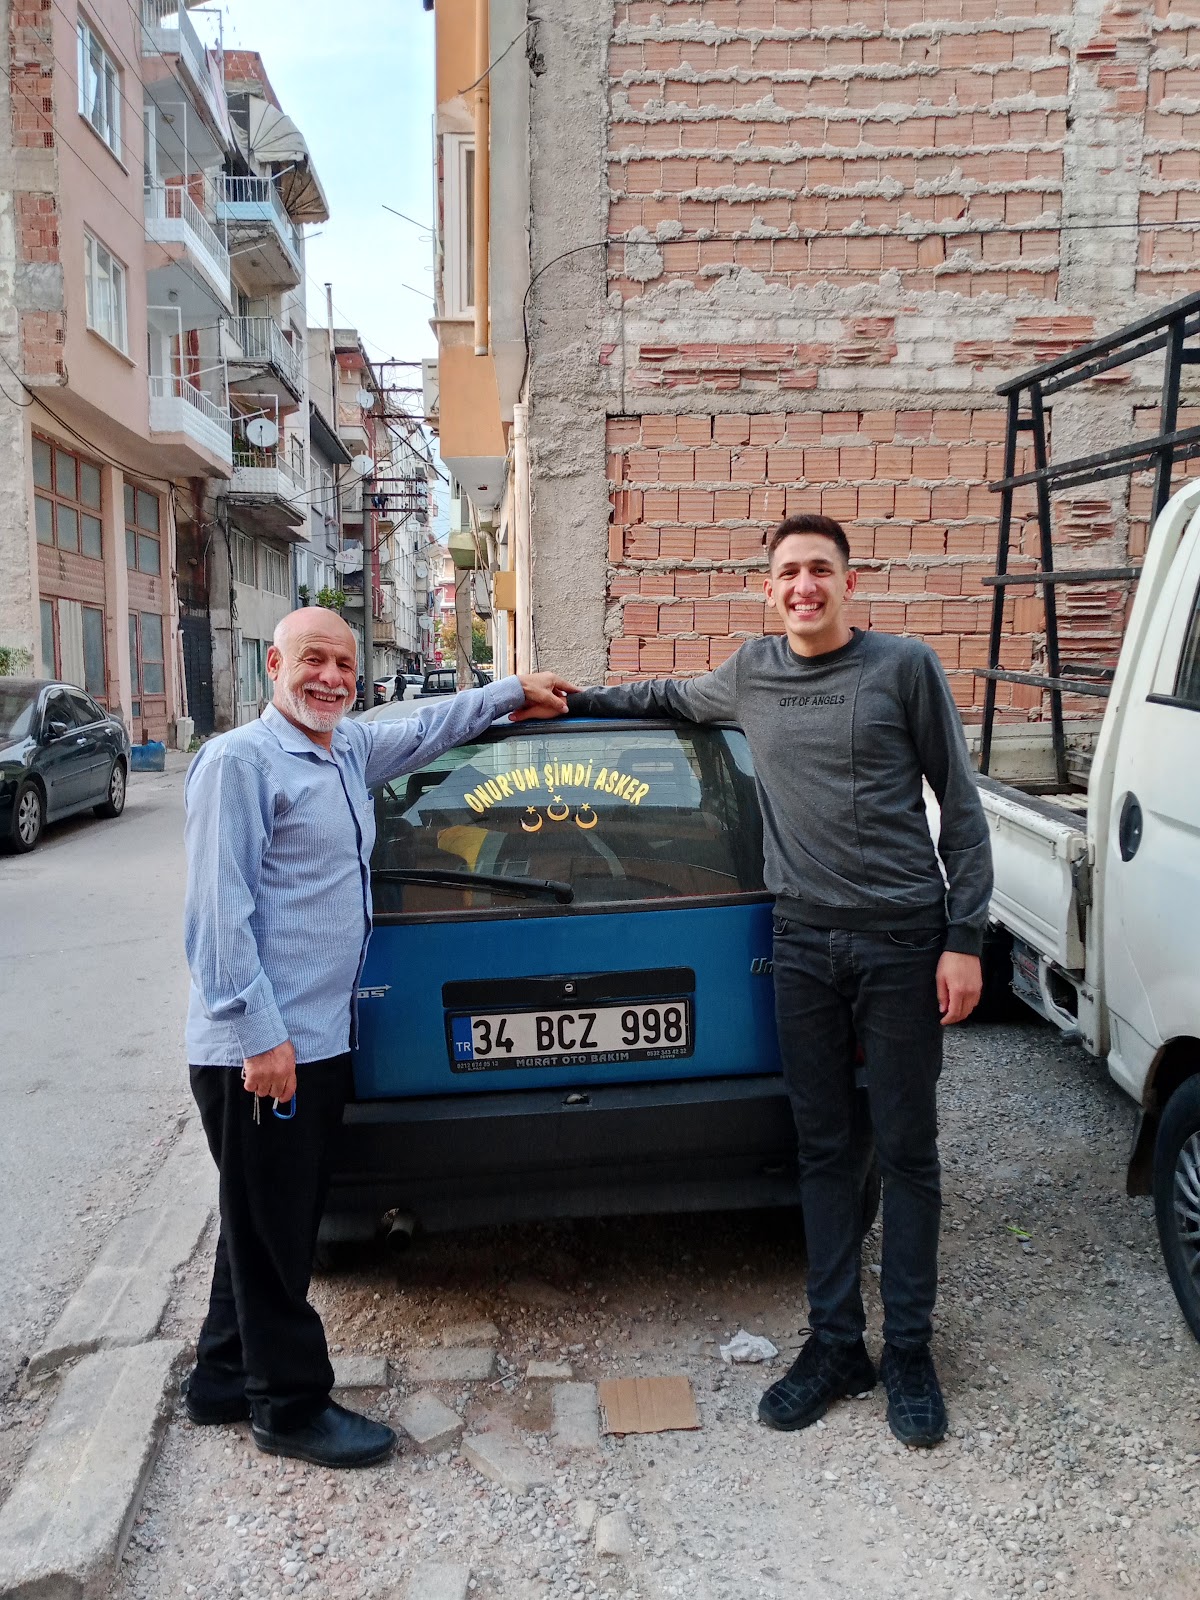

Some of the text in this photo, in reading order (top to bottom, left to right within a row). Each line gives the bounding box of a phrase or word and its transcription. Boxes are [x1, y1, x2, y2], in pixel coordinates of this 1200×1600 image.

[799, 696, 811, 707] OF
[811, 694, 845, 706] ANGELS
[464, 757, 650, 813] ONUR'UM ŞİMDİ ASKER
[750, 957, 773, 974] Un
[456, 1007, 683, 1055] TR 34 BCZ 998
[516, 1052, 630, 1068] MURAT OTO BAKIM
